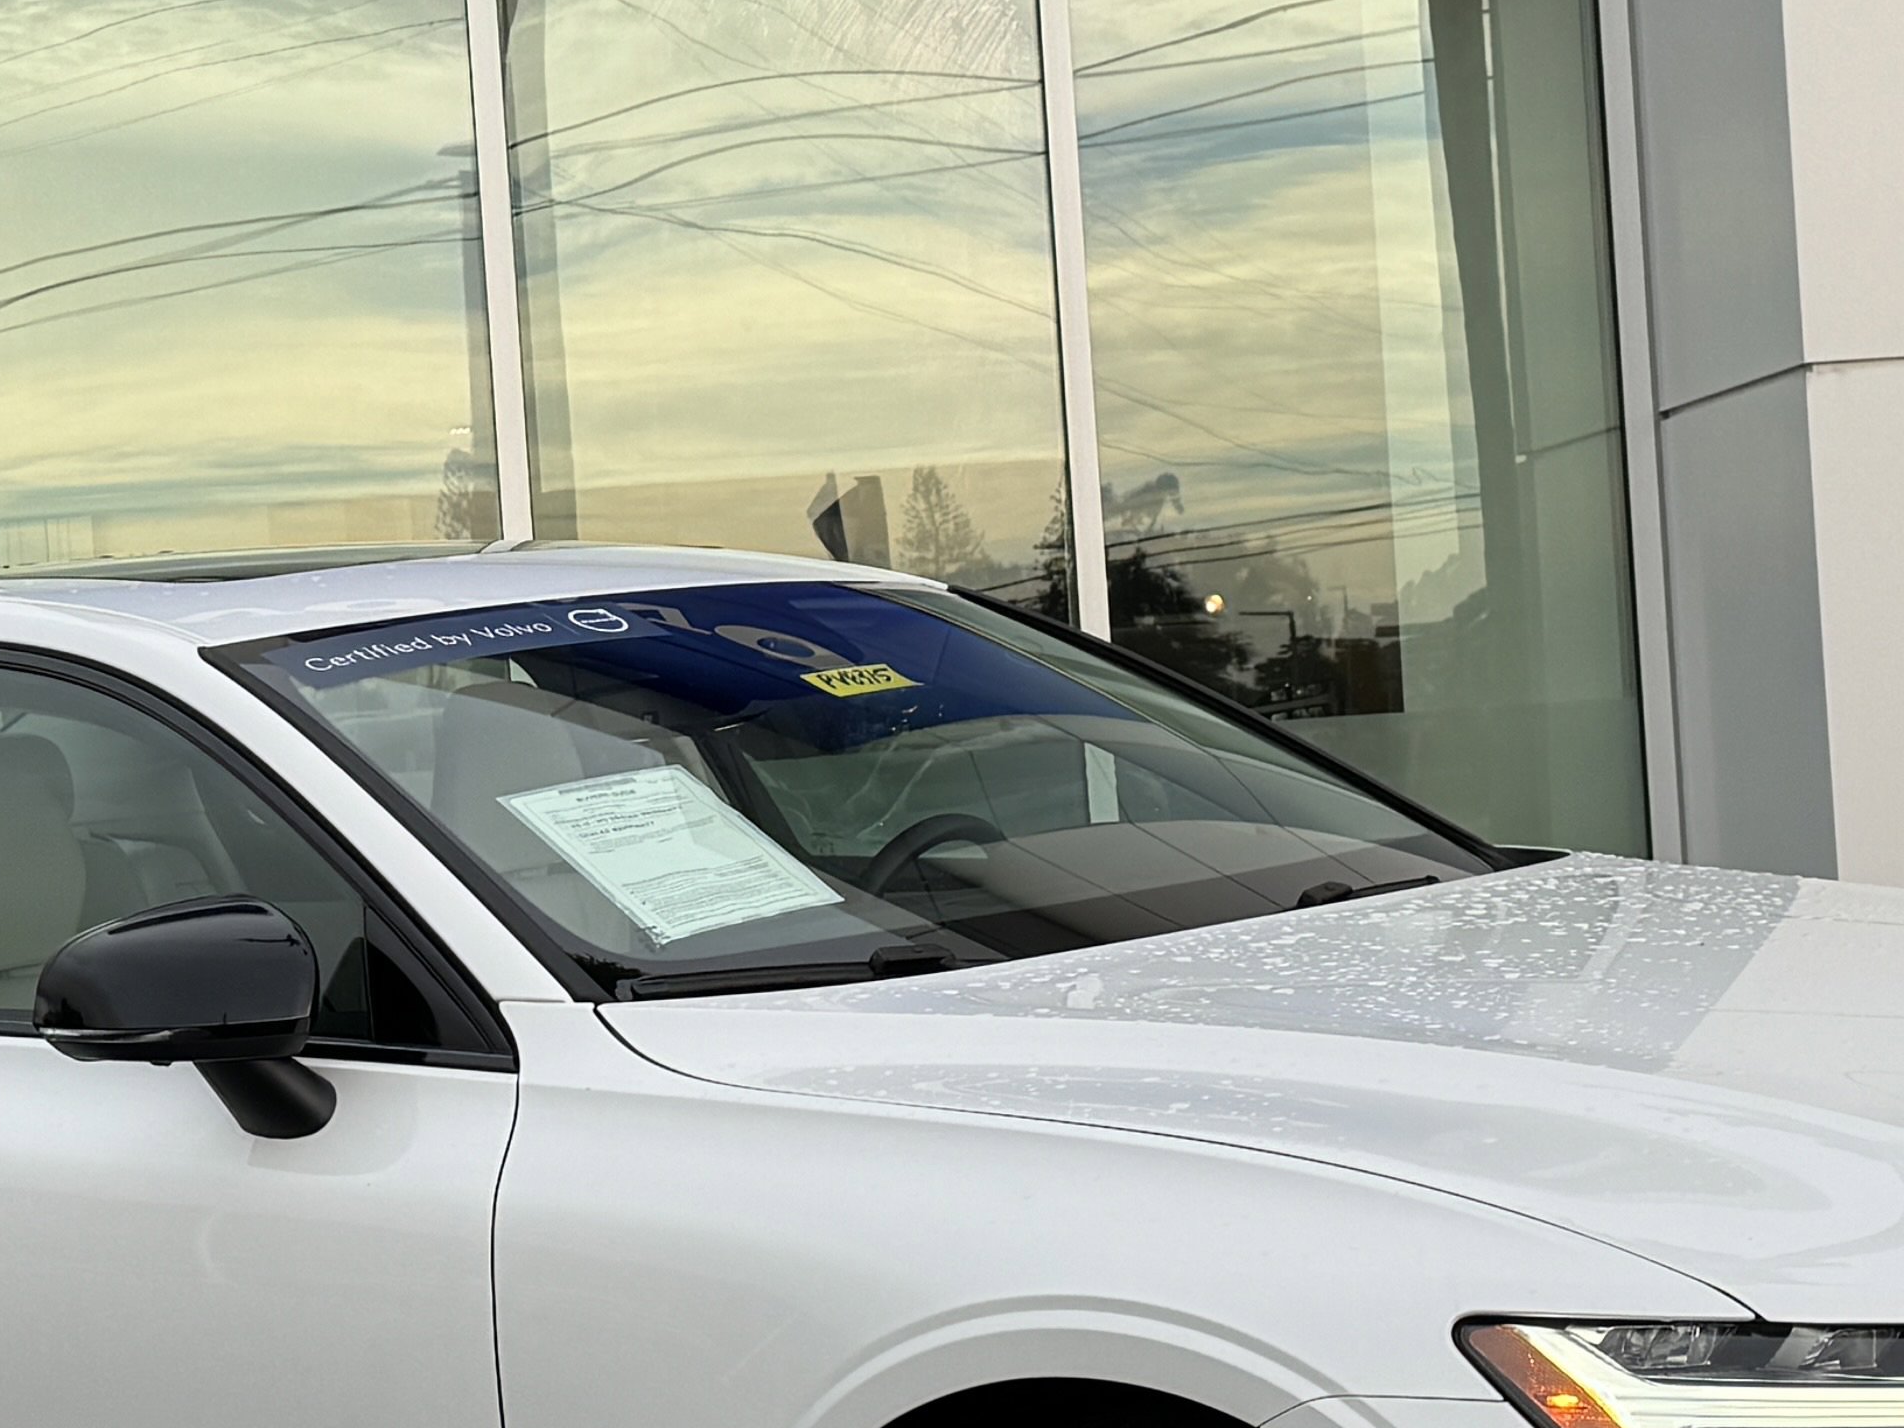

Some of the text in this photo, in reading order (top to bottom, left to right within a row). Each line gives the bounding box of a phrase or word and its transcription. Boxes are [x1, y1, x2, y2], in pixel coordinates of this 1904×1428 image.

[304, 620, 552, 672] Certified by Volvo
